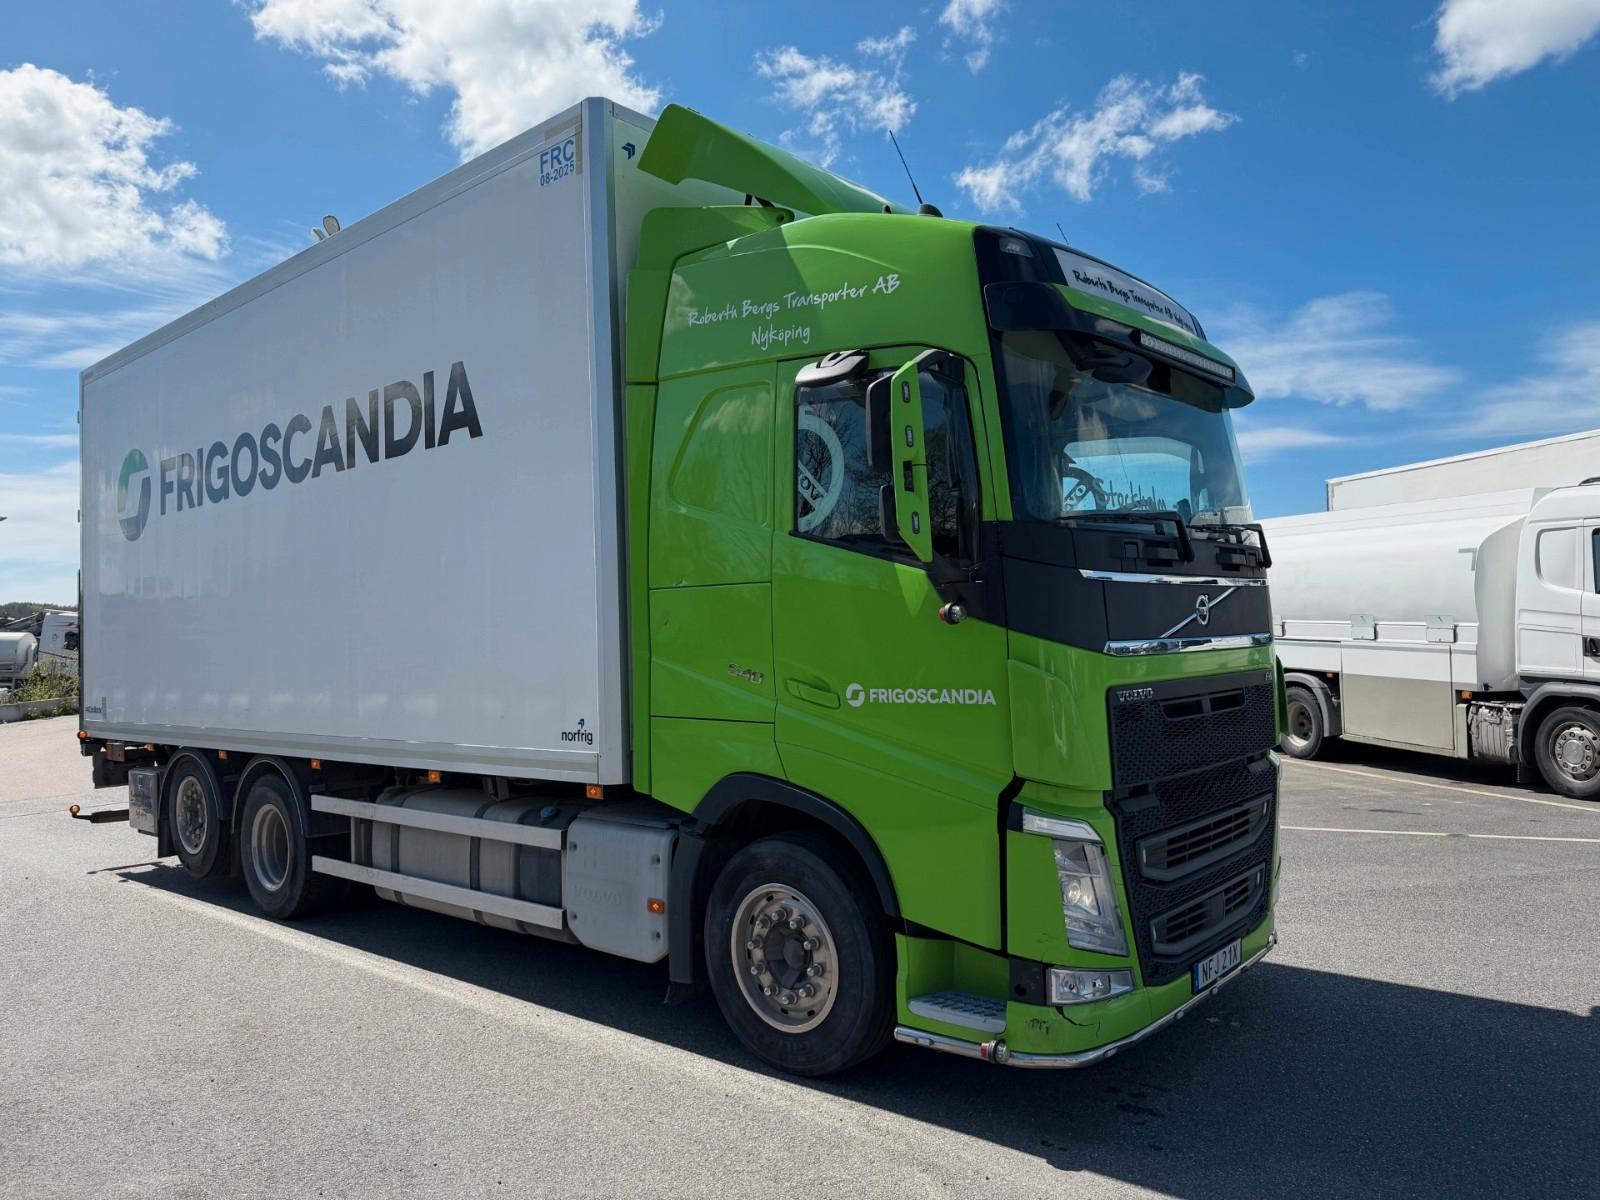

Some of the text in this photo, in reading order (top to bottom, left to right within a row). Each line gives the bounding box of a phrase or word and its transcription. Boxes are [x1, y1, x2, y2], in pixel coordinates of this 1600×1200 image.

[540, 140, 574, 174] FRC
[540, 160, 575, 186] 08-2025
[687, 273, 900, 327] Roberth Bergs Transporter AB
[751, 323, 811, 350] Nyköping
[160, 360, 483, 516] FRIGOSCANDIA
[869, 687, 997, 706] FRIGOSCANDIA
[1117, 687, 1154, 702] VOLVO
[561, 729, 593, 746] norfrig
